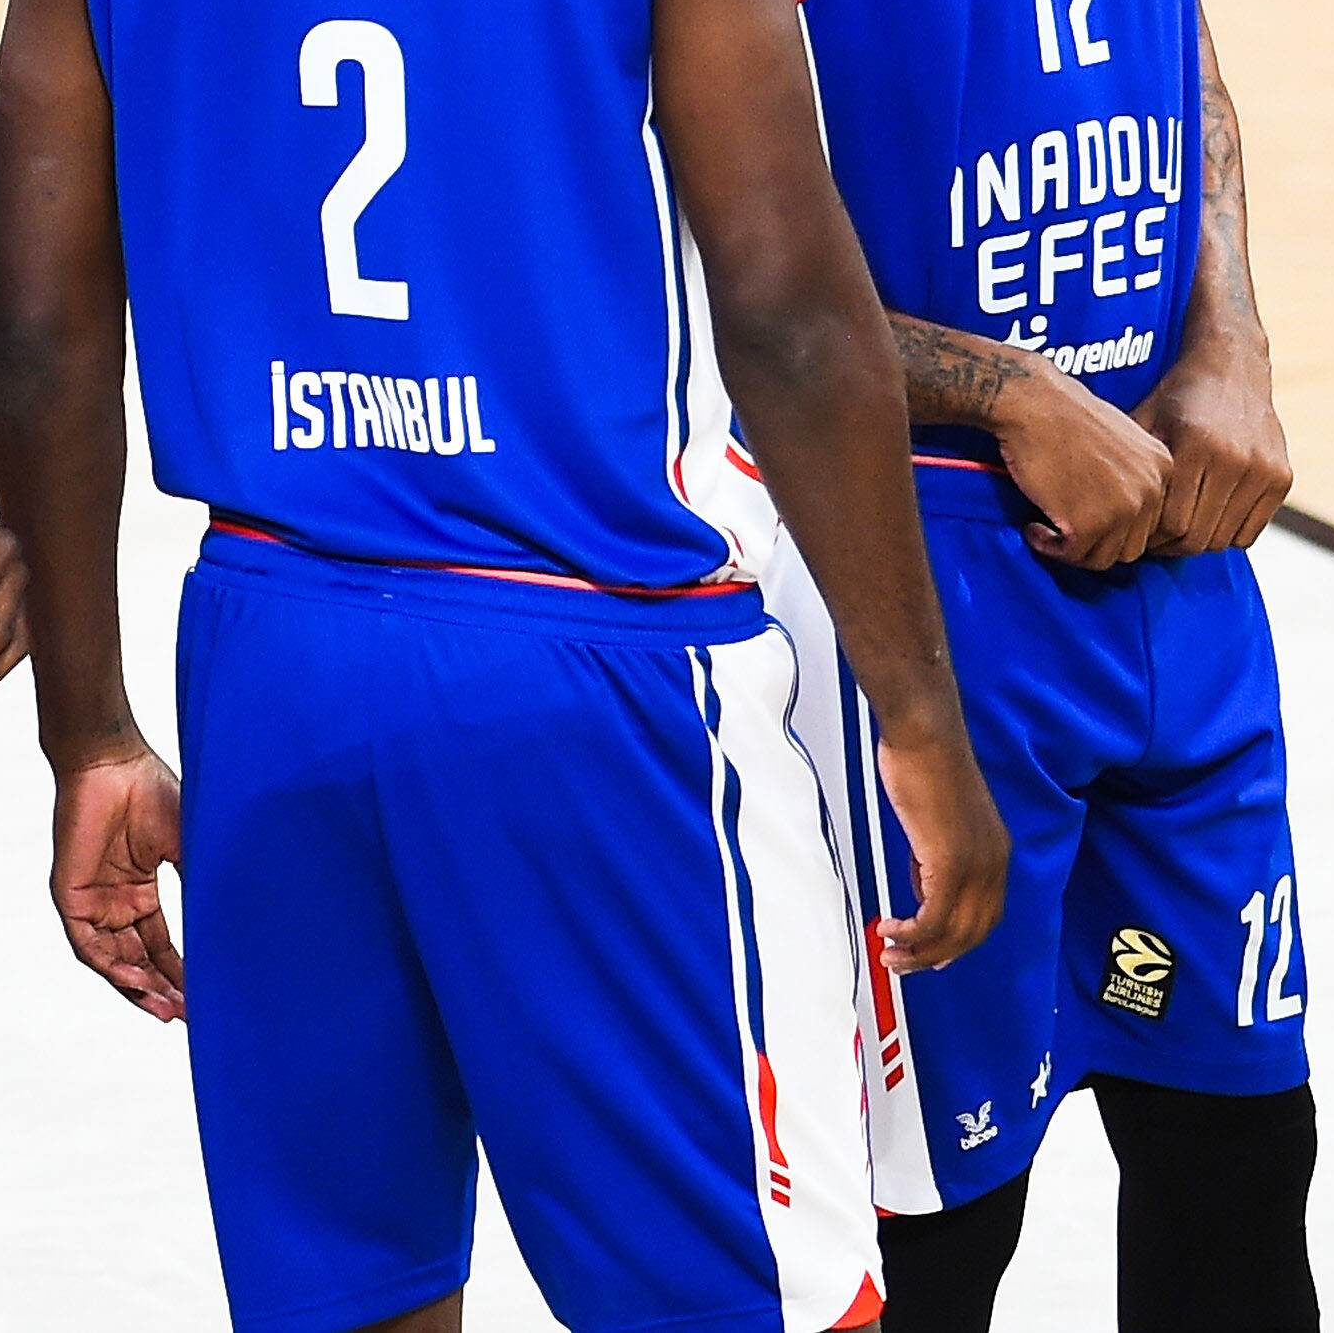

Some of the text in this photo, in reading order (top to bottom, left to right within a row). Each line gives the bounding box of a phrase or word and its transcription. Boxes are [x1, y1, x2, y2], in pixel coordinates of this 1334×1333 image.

[300, 20, 409, 321] 2
[978, 206, 1166, 314] EFES
[271, 361, 496, 455] İSTANBUL
[1238, 875, 1303, 1027] 12
